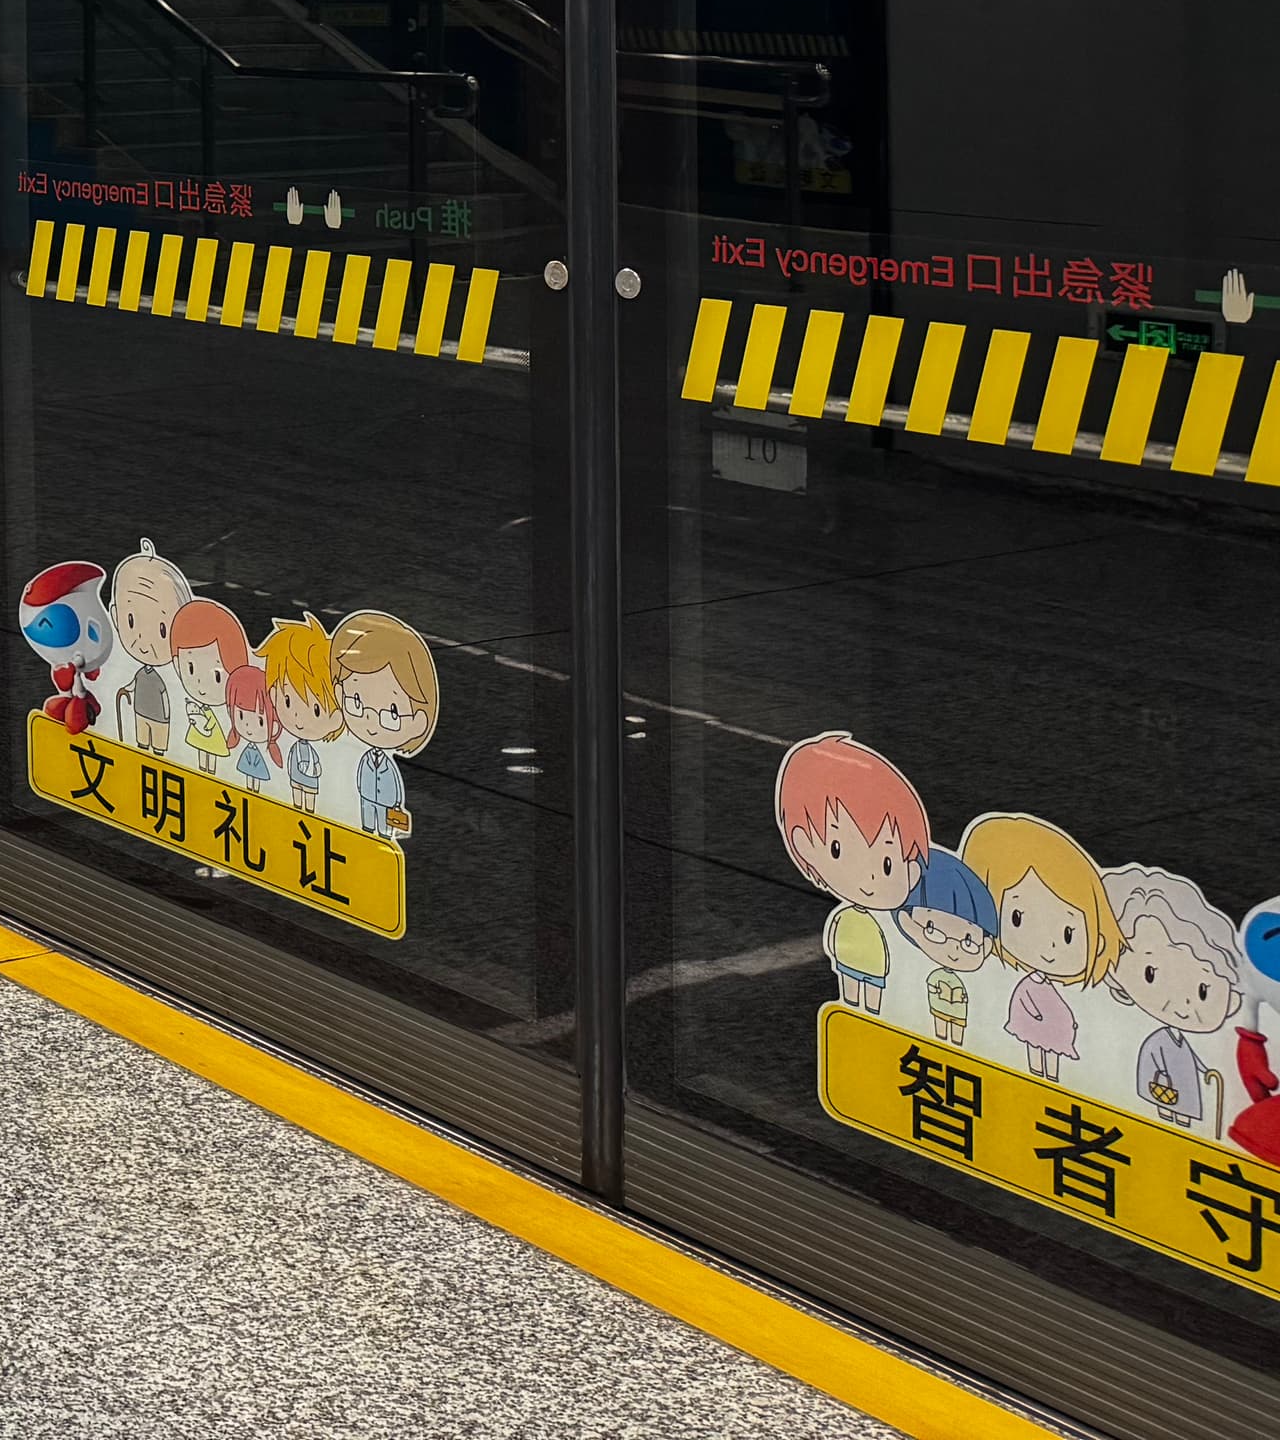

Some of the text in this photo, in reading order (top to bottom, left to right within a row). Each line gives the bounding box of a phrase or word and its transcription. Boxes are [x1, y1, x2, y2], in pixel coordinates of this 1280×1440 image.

[68, 738, 351, 907] 文明礼让
[898, 1043, 1280, 1274] 智者守
